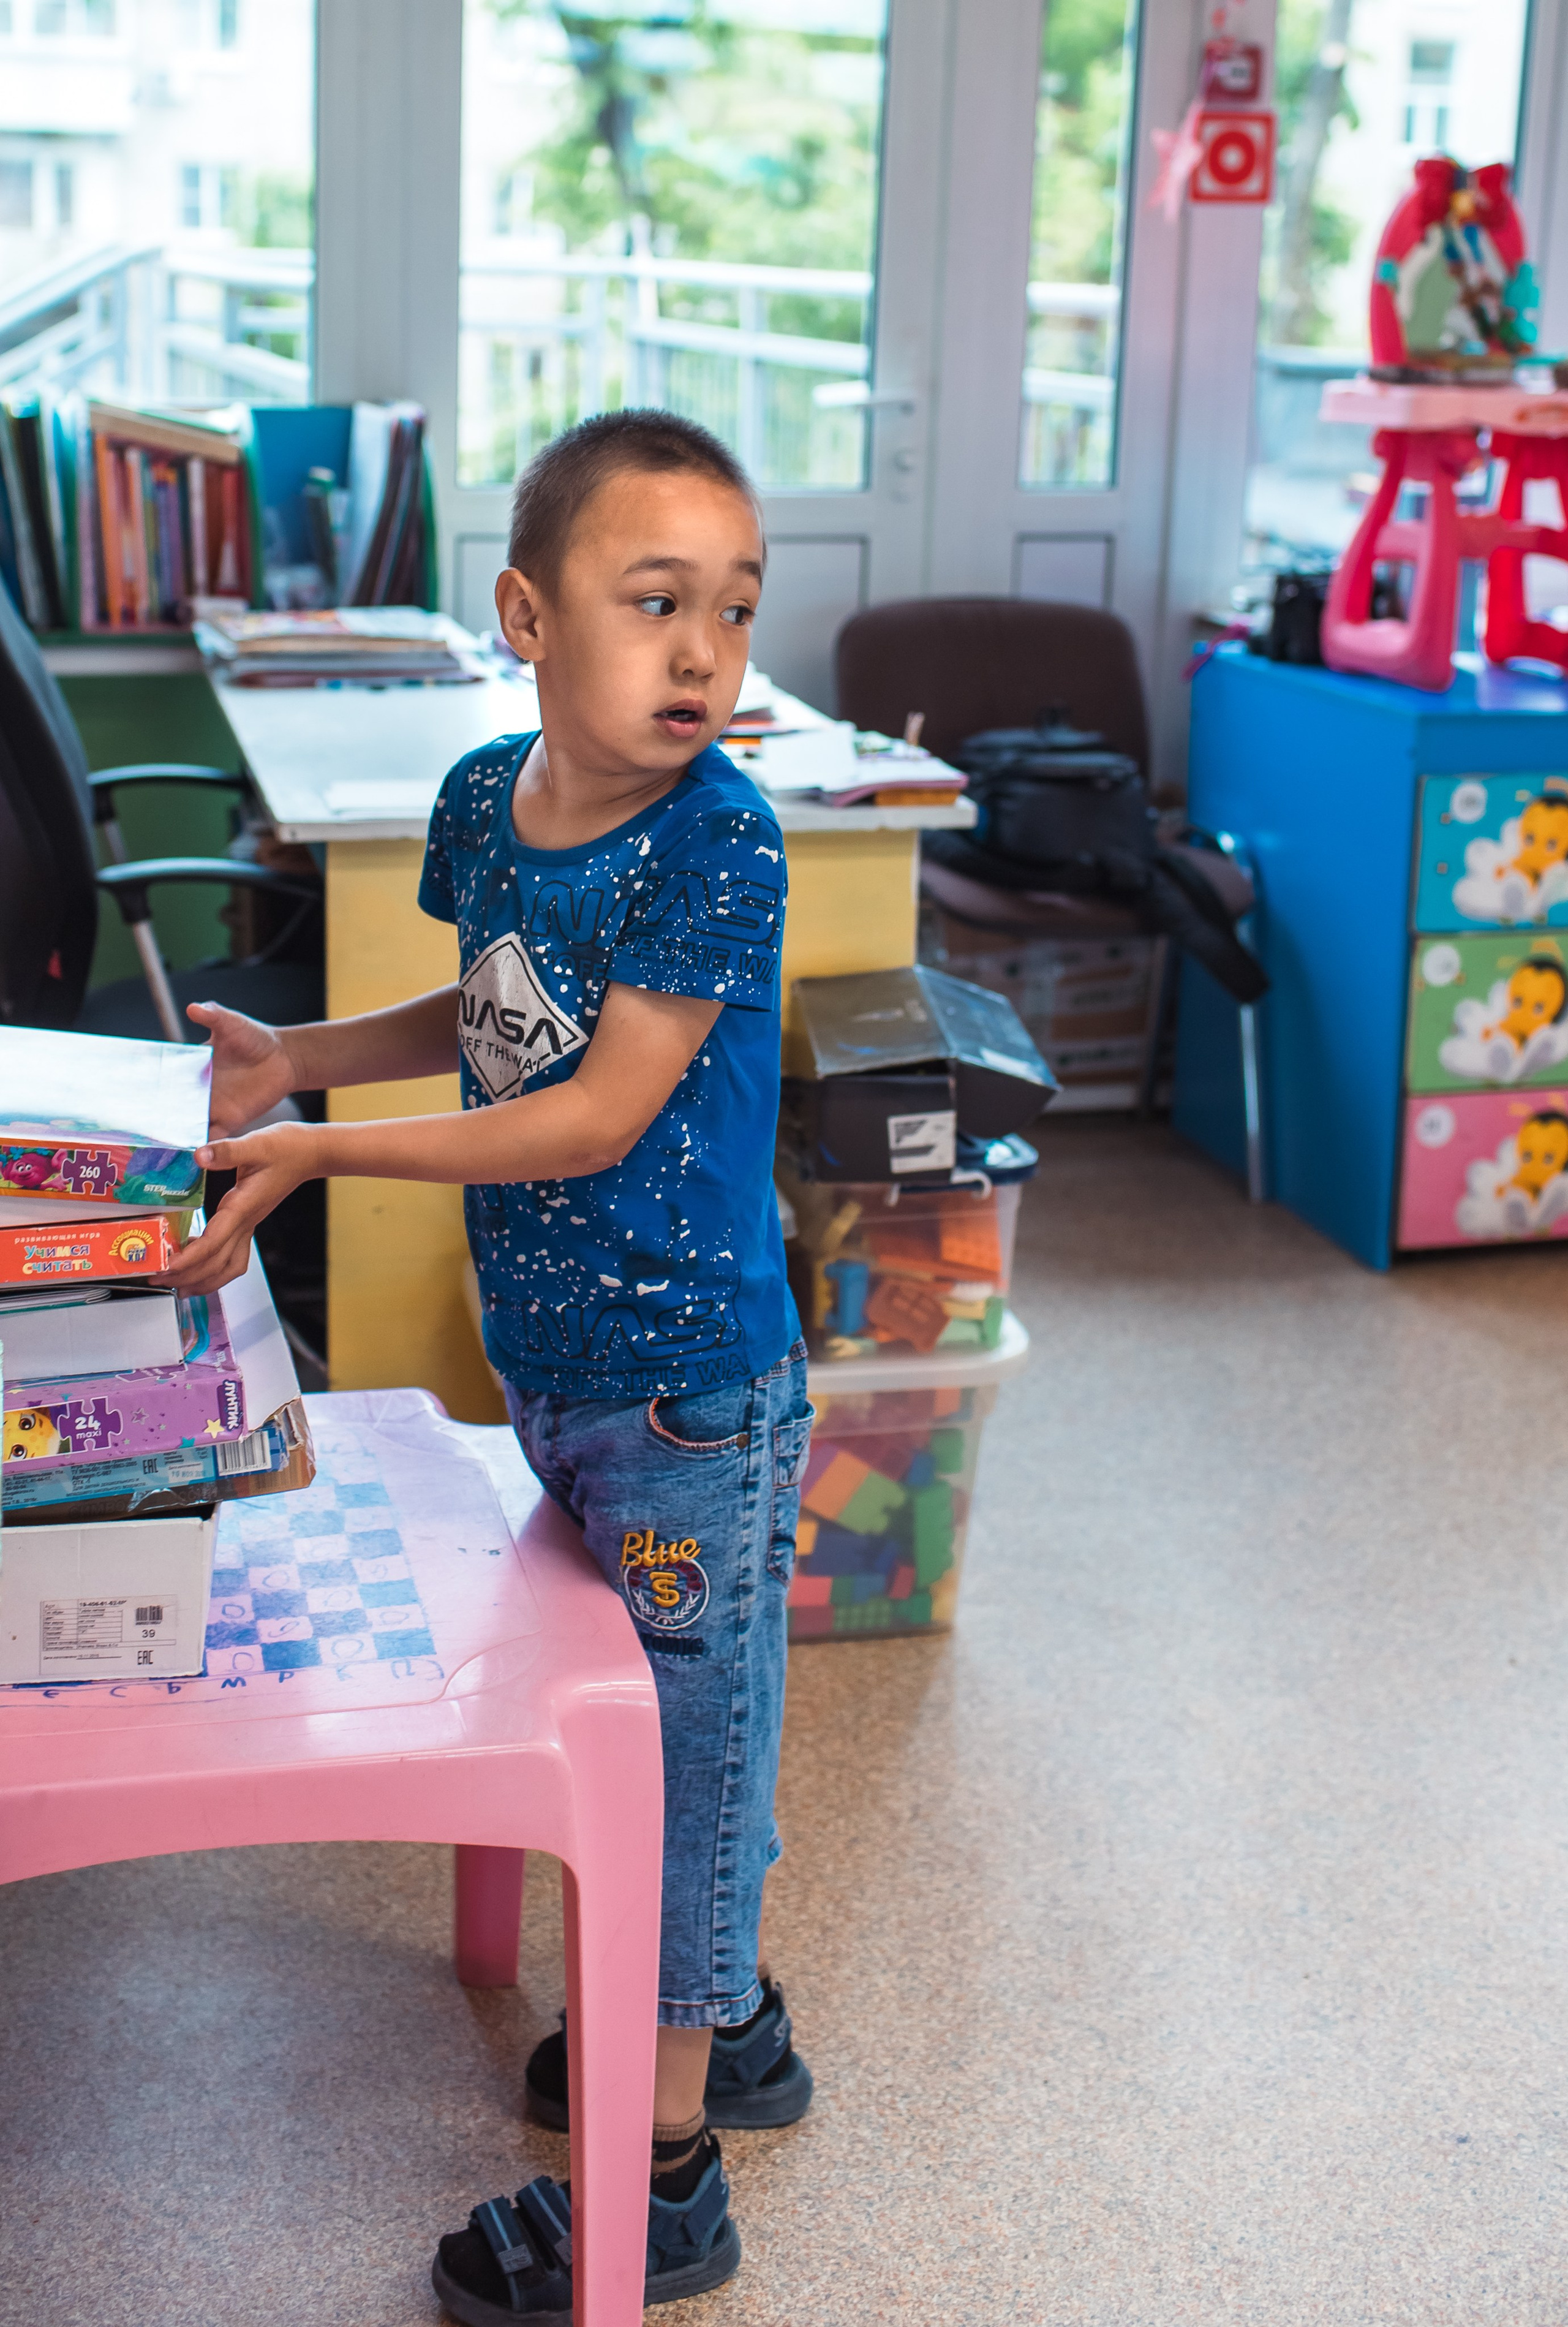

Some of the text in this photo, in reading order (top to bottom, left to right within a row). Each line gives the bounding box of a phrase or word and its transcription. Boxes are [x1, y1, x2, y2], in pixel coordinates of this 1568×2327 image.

[459, 988, 563, 1055] NASA
[486, 1042, 511, 1062] THE
[79, 1165, 100, 1179] 260
[144, 1184, 167, 1192] STEP
[79, 1232, 100, 1241] игра
[24, 1244, 91, 1260] Учимся
[224, 1380, 239, 1430] ЛУНТИК
[75, 1415, 101, 1431] 24
[76, 1428, 102, 1440] maxi
[622, 1529, 701, 1567] Blue
[141, 1629, 156, 1638] 39
